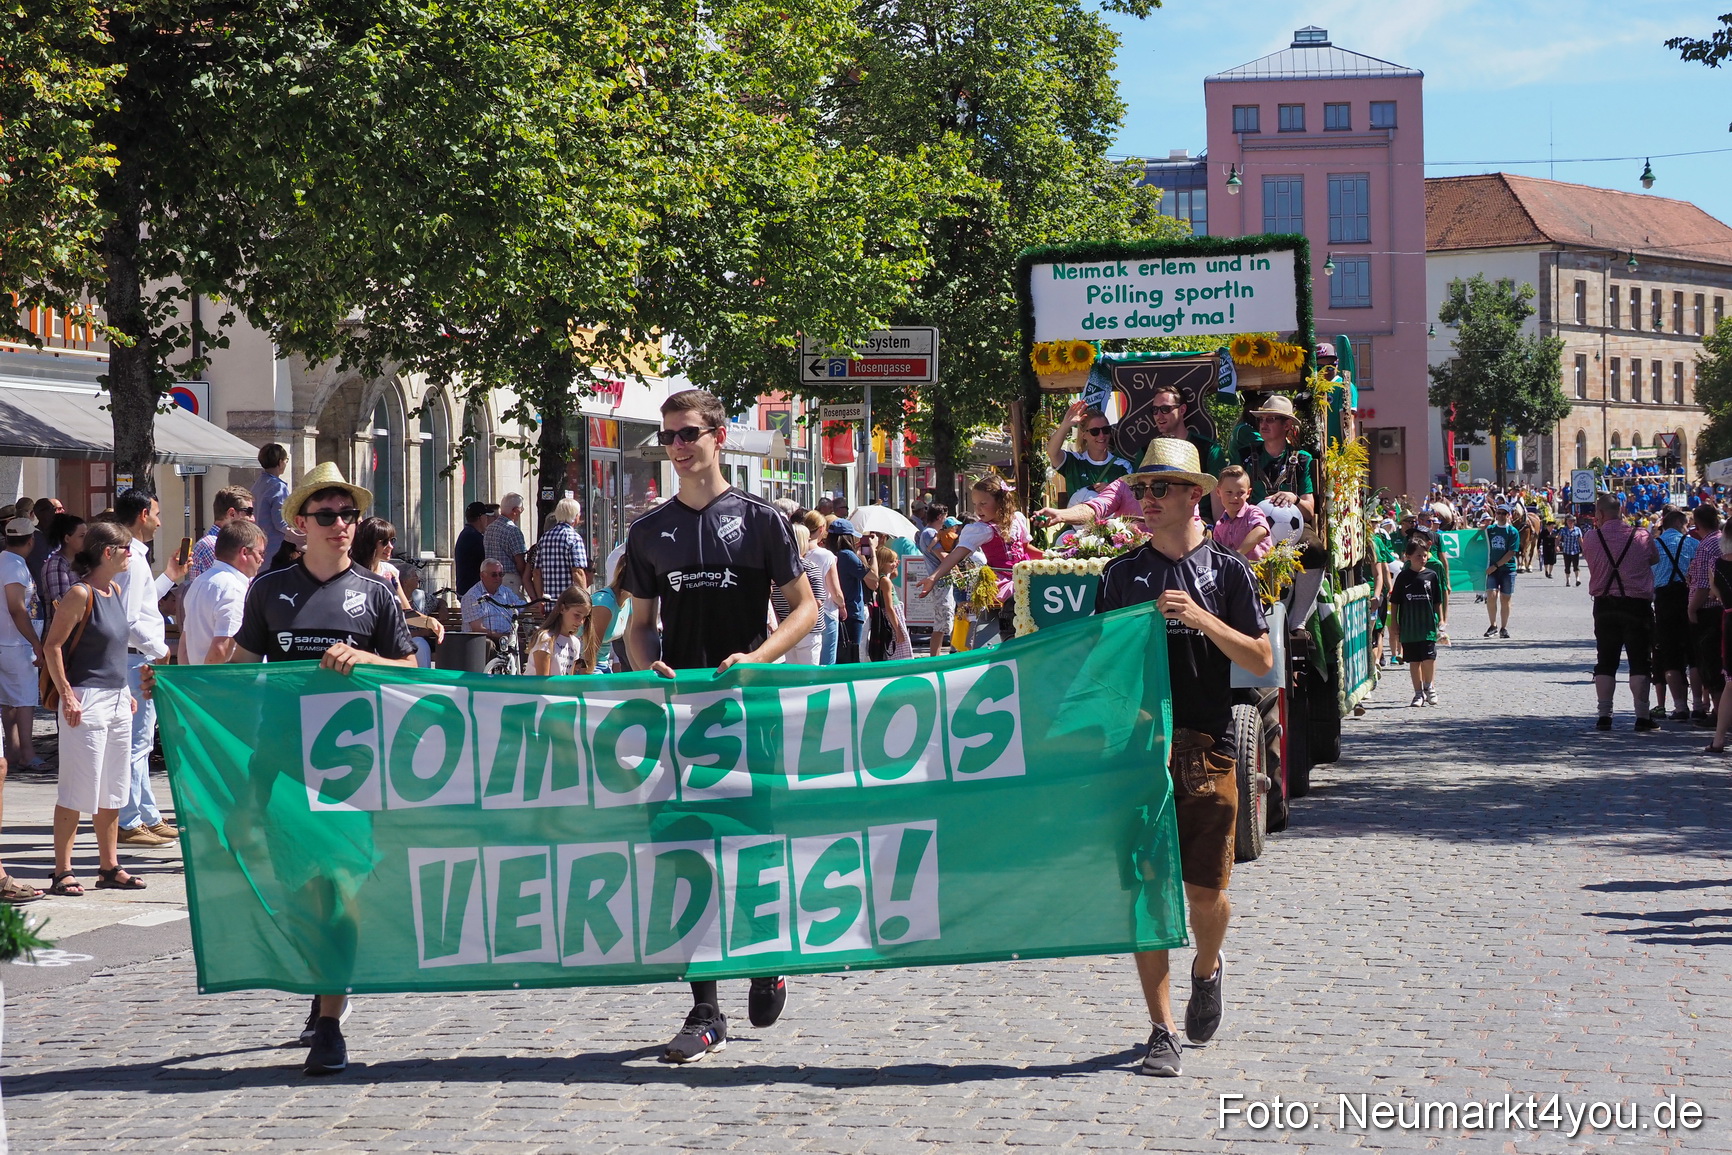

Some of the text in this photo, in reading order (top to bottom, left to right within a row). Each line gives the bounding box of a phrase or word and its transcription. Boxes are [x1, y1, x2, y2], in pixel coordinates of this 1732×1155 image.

[1138, 257, 1196, 277] erlem
[1206, 255, 1242, 273] und
[1250, 254, 1271, 272] in
[1087, 283, 1163, 309] Pölling
[1081, 310, 1118, 331] des
[1124, 307, 1186, 333] daugt
[855, 362, 911, 376] Rosengasse
[1133, 373, 1158, 390] SV
[823, 407, 861, 419] Rosengasse
[1125, 387, 1196, 442] PÖLG
[1043, 584, 1087, 614] SV
[309, 663, 1017, 805] SOMOS LOS
[417, 827, 935, 962] VERDES!
